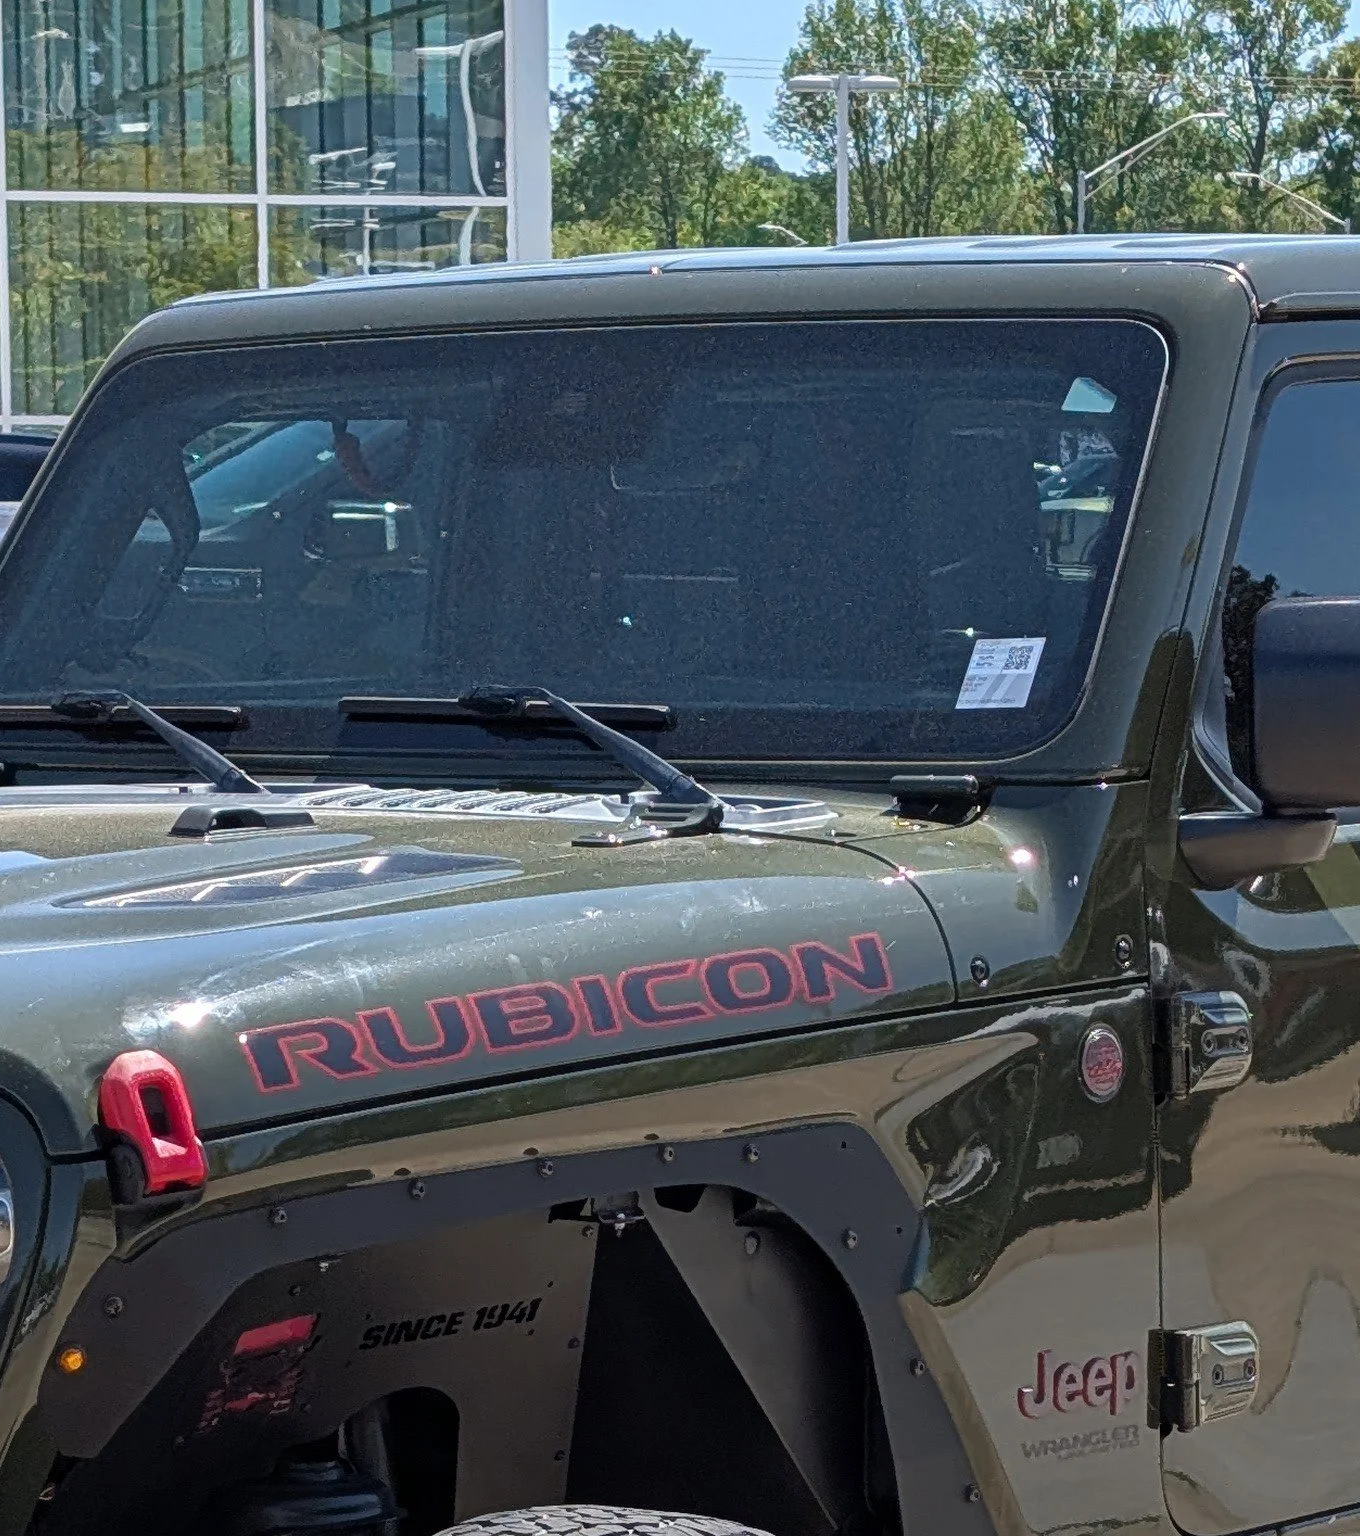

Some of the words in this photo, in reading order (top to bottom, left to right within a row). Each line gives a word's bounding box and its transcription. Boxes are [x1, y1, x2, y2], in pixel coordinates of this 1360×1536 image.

[236, 931, 894, 1093] RUBICON
[358, 1311, 465, 1350] SINCE
[473, 1297, 543, 1331] 1941
[1017, 1348, 1141, 1420] Jeep
[1021, 1424, 1139, 1459] WRANGLER
